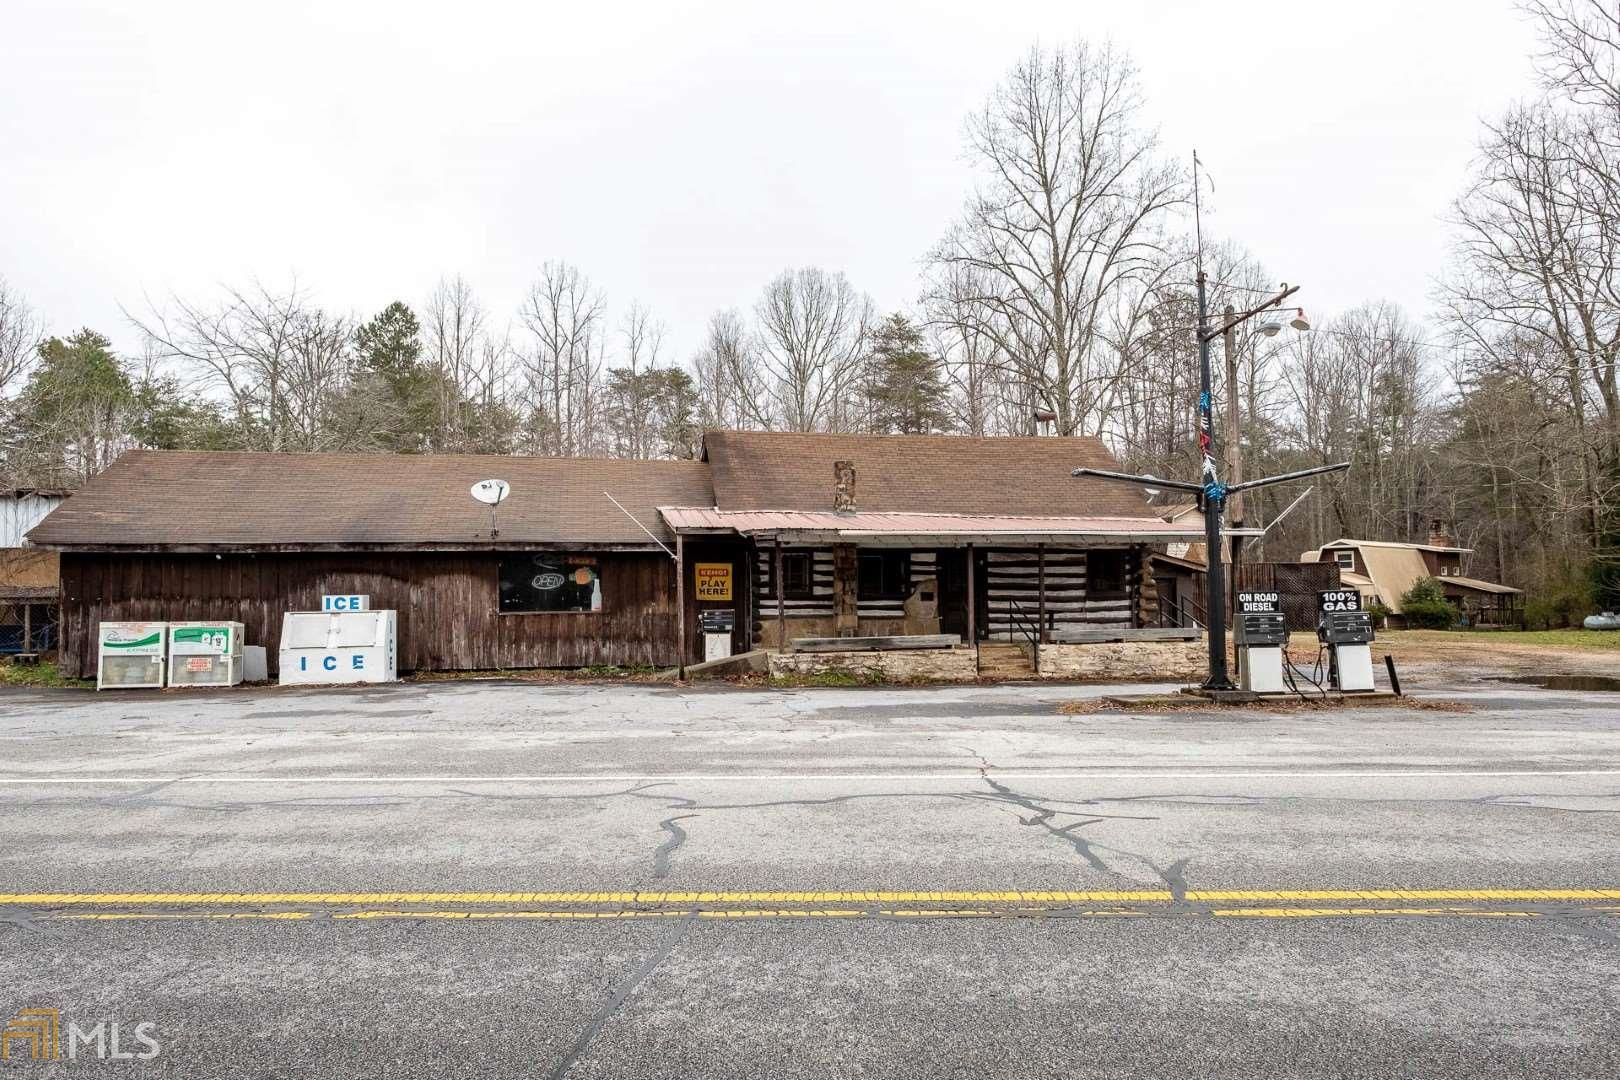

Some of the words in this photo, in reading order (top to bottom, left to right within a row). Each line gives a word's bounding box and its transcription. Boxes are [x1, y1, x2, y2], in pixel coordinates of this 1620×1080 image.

[534, 575, 562, 586] OPEN
[1239, 593, 1252, 602] ON
[1254, 593, 1278, 602] ROAD
[1322, 592, 1357, 601] 100%
[325, 597, 360, 610] ICE
[1243, 602, 1275, 611] DIESEL
[1323, 602, 1358, 611] GAS
[301, 655, 365, 671] ICE
